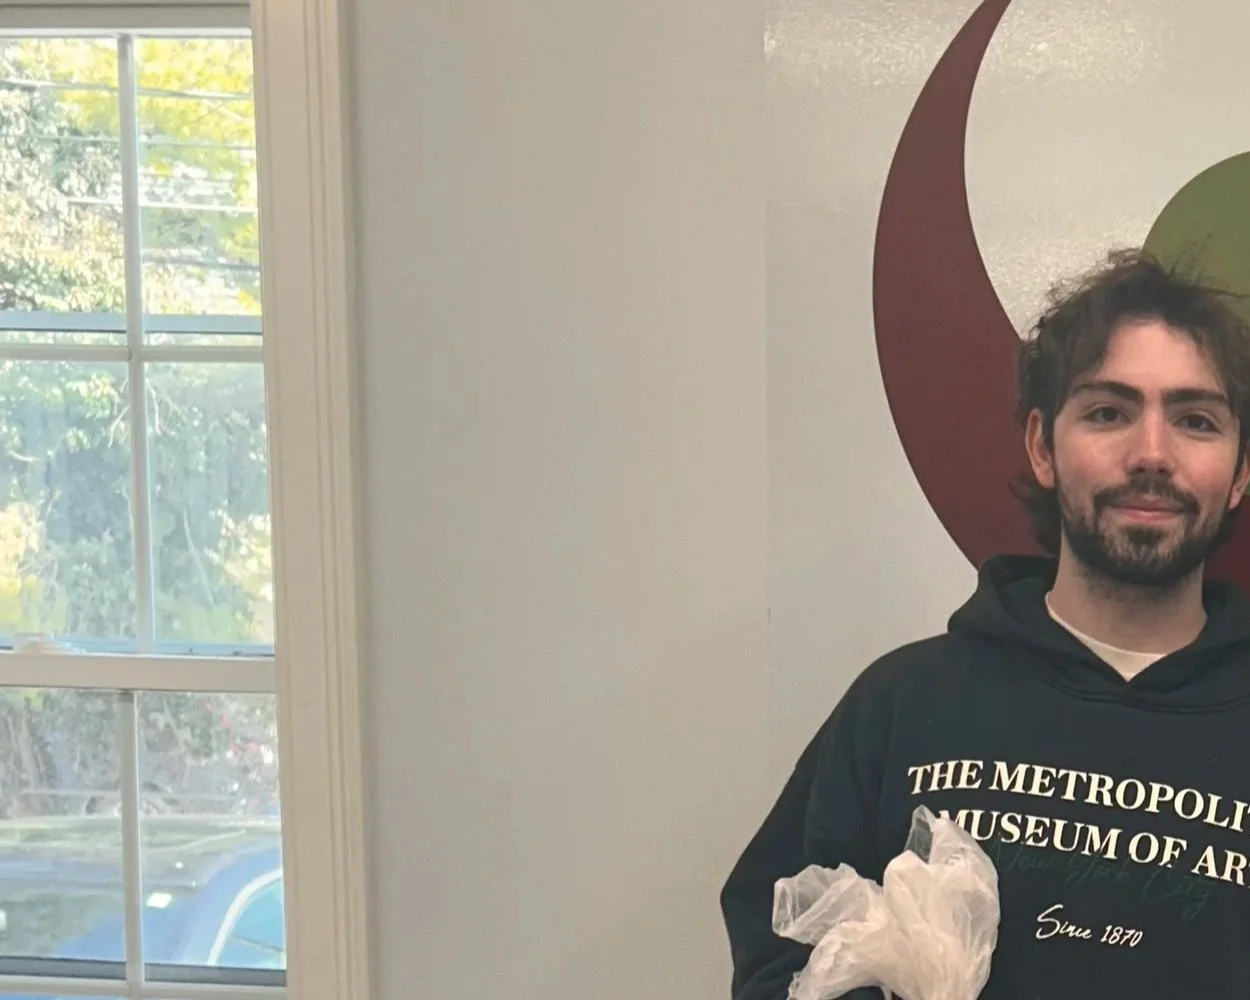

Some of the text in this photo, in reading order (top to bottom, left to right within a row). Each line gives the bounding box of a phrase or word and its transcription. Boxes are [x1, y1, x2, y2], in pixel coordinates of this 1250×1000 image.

[907, 760, 984, 795] THE
[1128, 832, 1187, 869] OF
[1062, 852, 1132, 892] York
[1141, 864, 1217, 922] City
[1035, 904, 1143, 948] Since 1870
